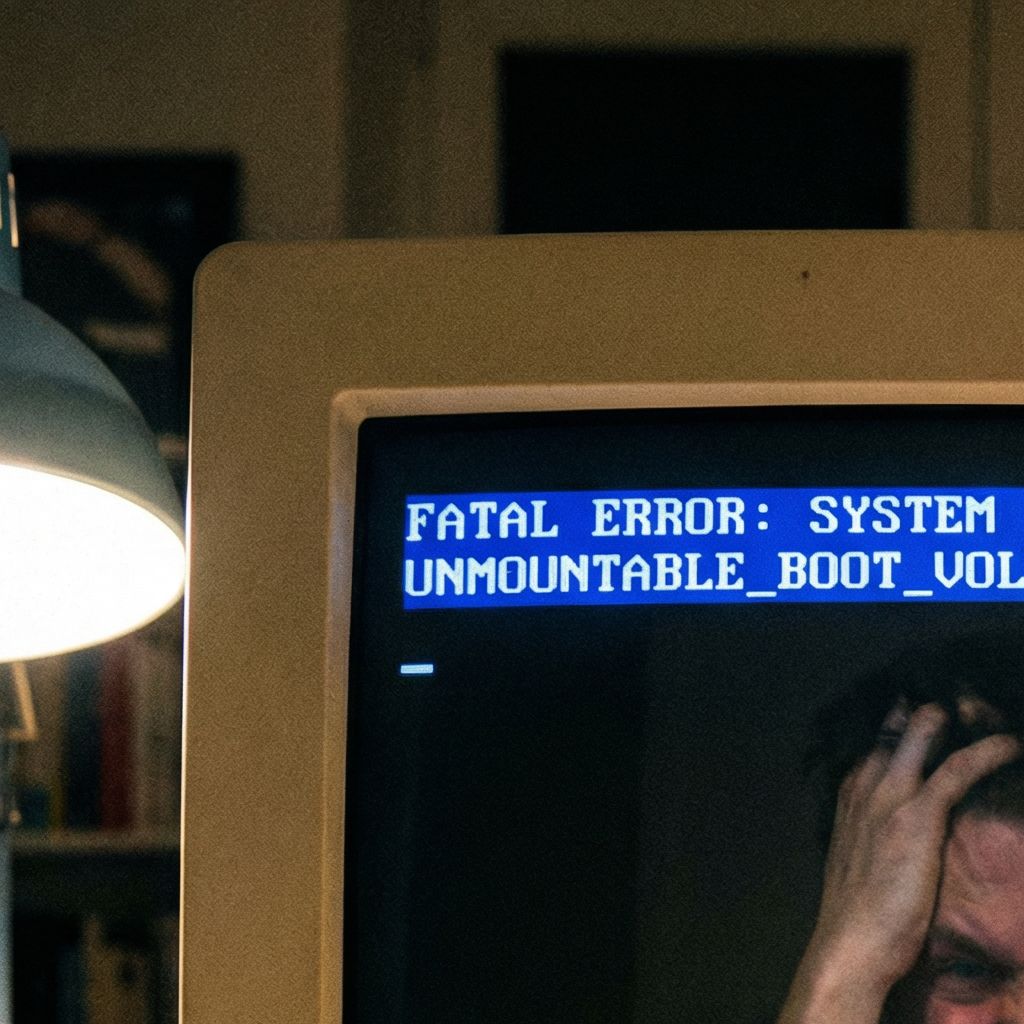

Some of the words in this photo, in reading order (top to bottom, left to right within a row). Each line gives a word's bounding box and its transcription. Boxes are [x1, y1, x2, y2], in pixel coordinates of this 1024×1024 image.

[405, 500, 559, 542] FATAL
[591, 496, 769, 537] ERROR:
[809, 495, 996, 534] SYSTEM
